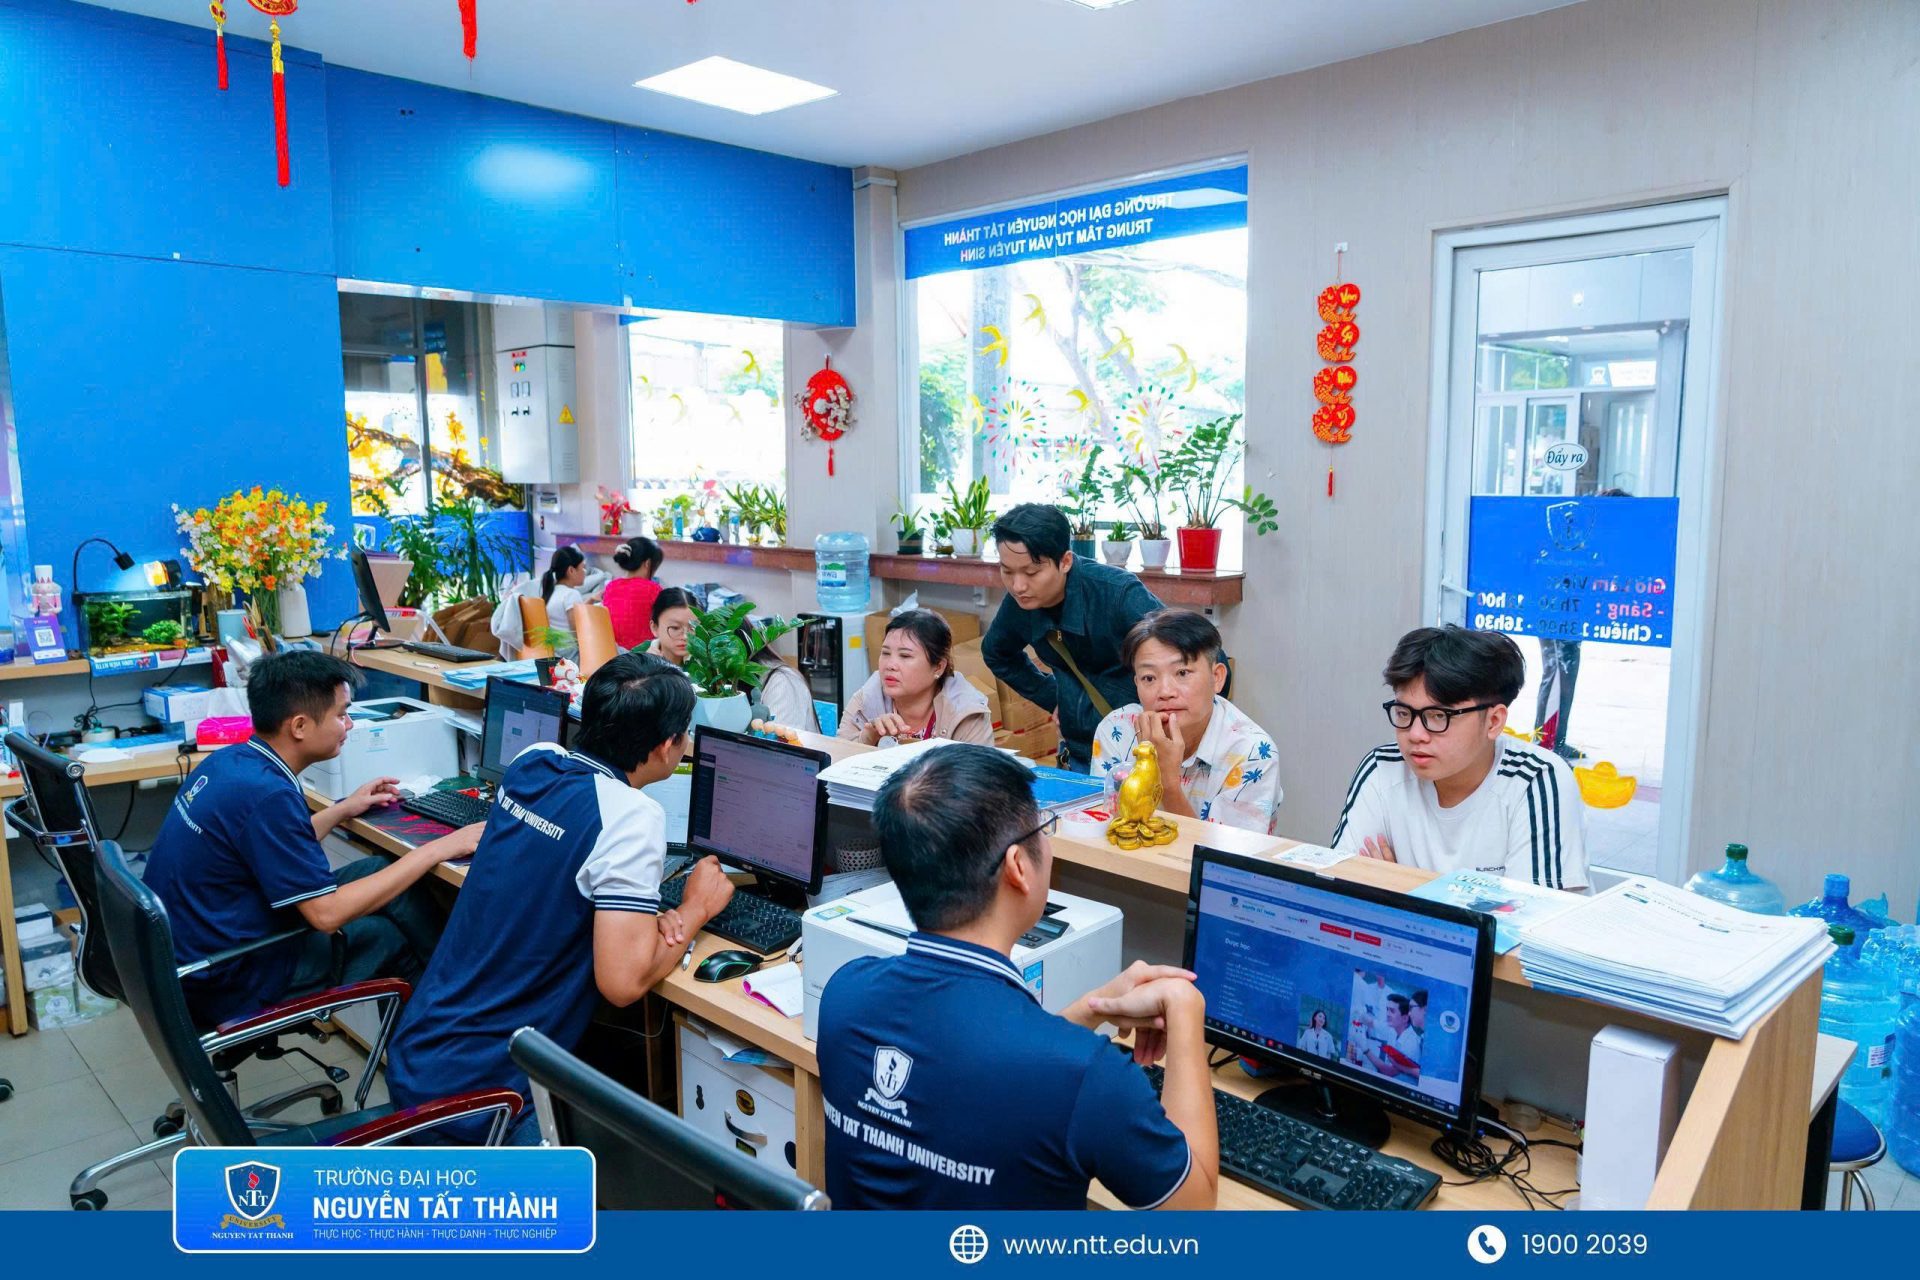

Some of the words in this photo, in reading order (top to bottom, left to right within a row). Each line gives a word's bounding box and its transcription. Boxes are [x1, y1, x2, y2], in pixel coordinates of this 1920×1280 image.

[1547, 447, 1568, 466] Đẩy
[1571, 453, 1583, 463] ra
[524, 810, 566, 841] UNIVERSITY
[879, 1109, 892, 1121] TAT
[891, 1113, 913, 1129] THANH
[842, 1113, 860, 1139] TAT
[862, 1123, 904, 1157] THANH
[907, 1142, 996, 1186] UNIVERSITY
